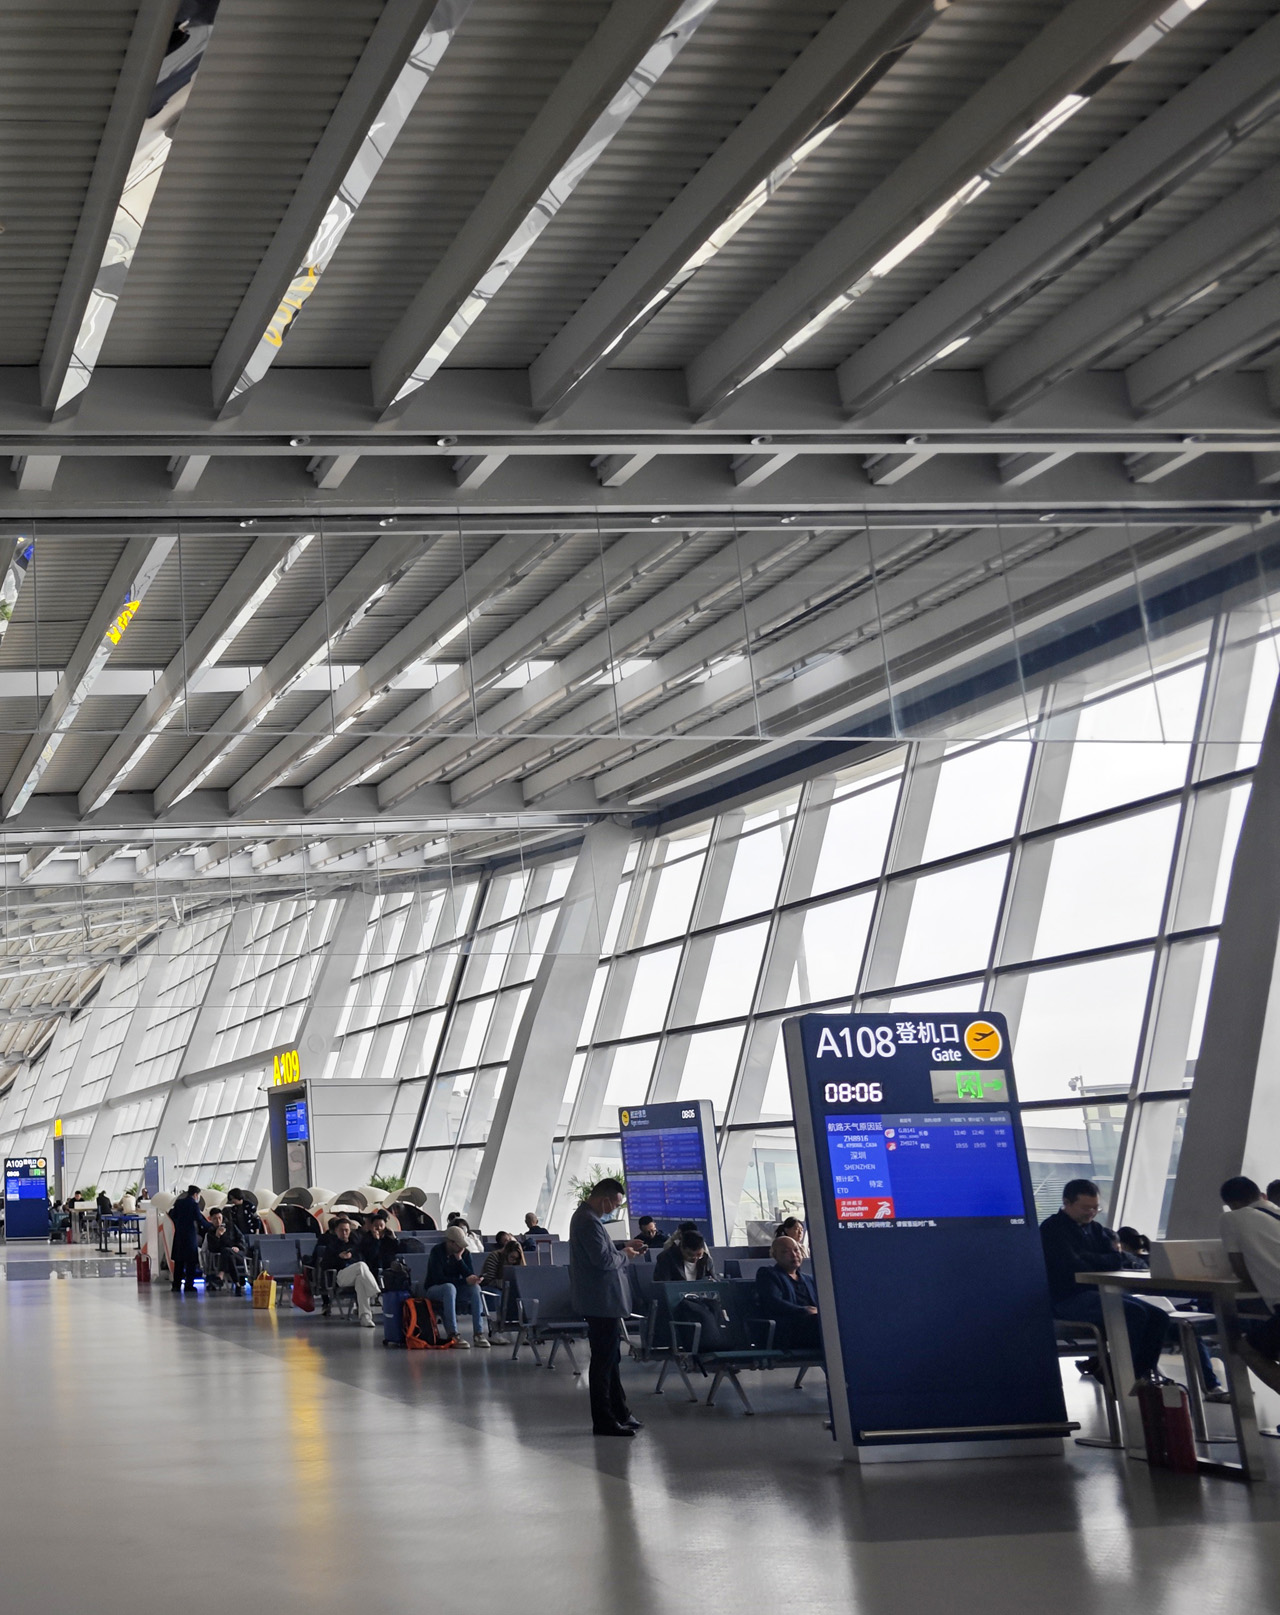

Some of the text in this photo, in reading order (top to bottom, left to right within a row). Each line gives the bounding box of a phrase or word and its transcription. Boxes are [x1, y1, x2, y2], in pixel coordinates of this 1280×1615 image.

[816, 1021, 960, 1058] A108 登机口
[931, 1047, 962, 1062] Gate
[273, 1050, 300, 1087] A109
[825, 1082, 883, 1103] 08:06
[827, 1122, 884, 1132] 航路天气原因延
[850, 1151, 867, 1160] 深圳
[6, 1160, 23, 1168] A109
